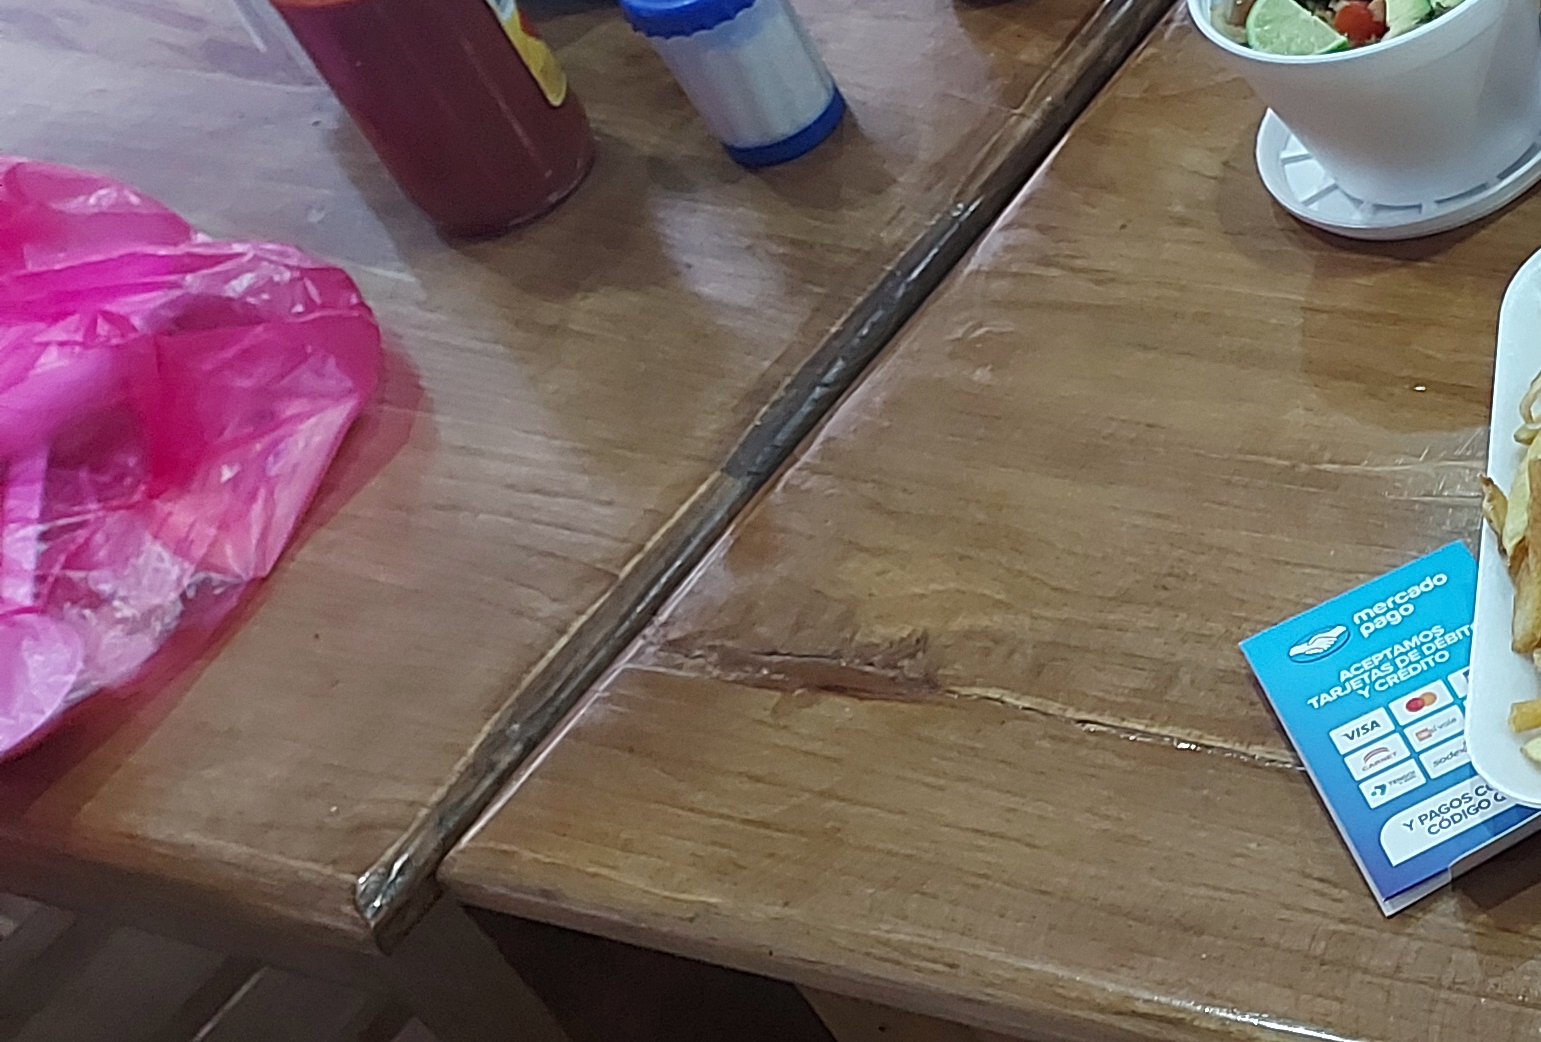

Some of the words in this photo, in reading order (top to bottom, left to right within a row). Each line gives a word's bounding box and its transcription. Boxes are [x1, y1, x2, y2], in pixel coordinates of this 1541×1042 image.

[1352, 572, 1449, 625] mercado
[1359, 601, 1416, 639] pago
[1306, 660, 1394, 710] TARJETAS
[1394, 648, 1421, 670] DE
[1421, 622, 1475, 655] DÉBIT
[1339, 624, 1446, 683] ACEPTAMOS
[1356, 685, 1371, 699] Y
[1374, 649, 1450, 692] CRÉDITO
[1341, 719, 1382, 742] VISA
[1361, 750, 1398, 773] CARNET
[1402, 818, 1415, 832] Y
[1417, 791, 1474, 826] PAGOS
[1427, 798, 1492, 836] CÓDIGO
